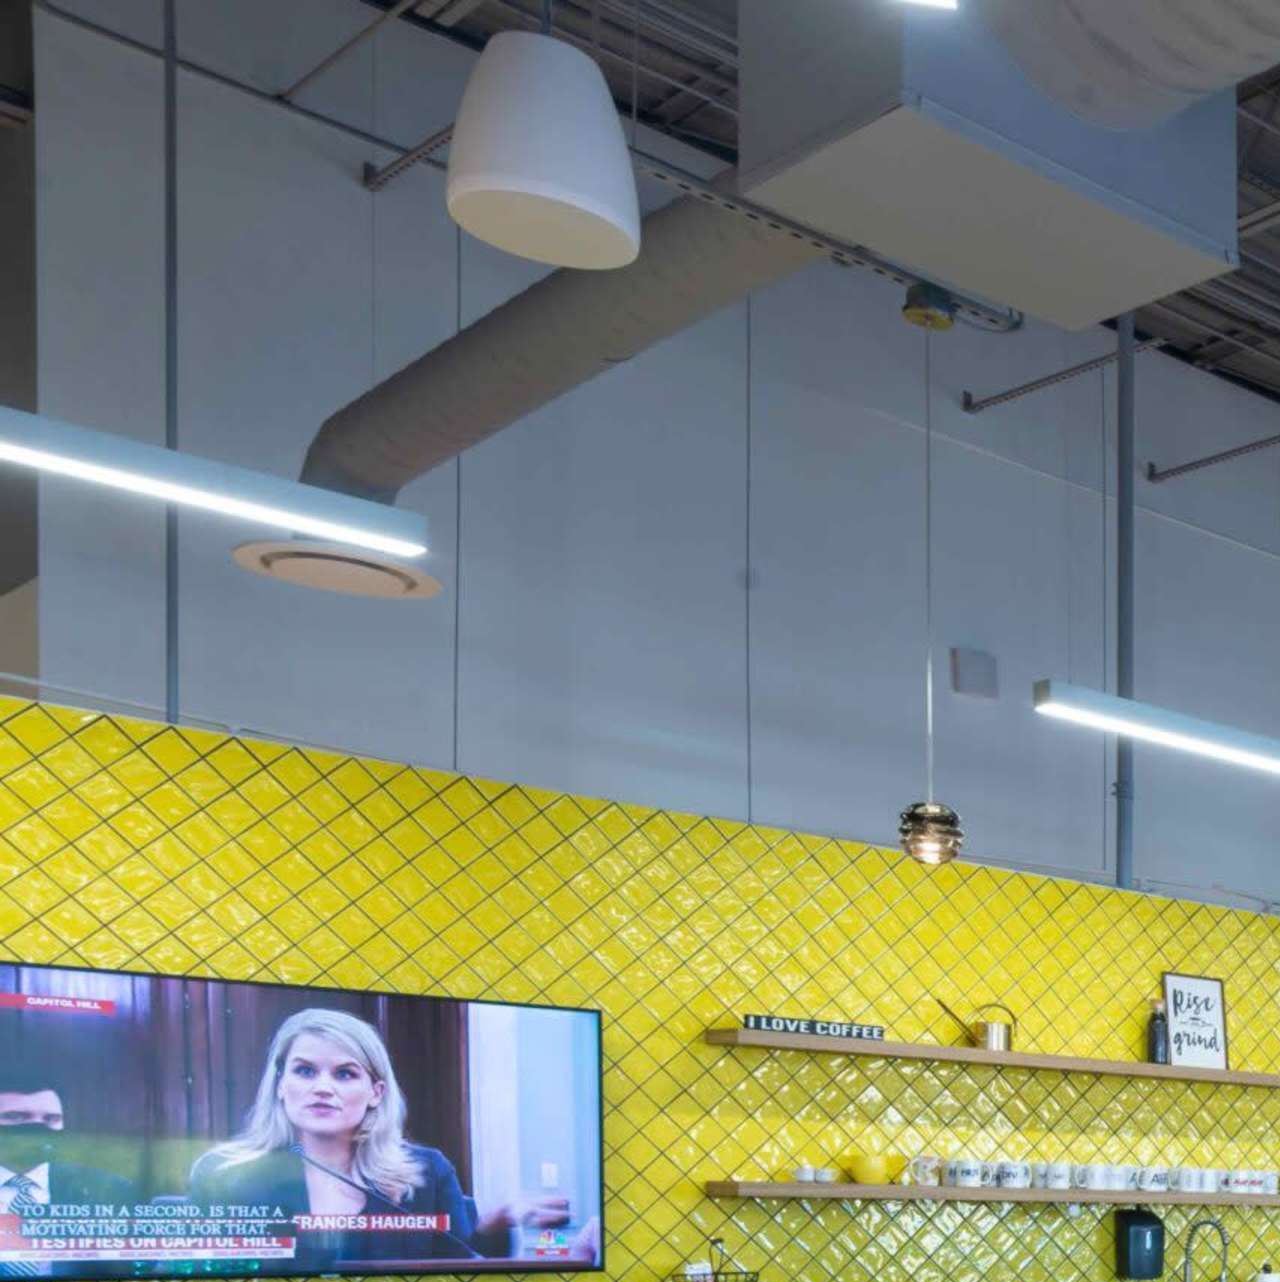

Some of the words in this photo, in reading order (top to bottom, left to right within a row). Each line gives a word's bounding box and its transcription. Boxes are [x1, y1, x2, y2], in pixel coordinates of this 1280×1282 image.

[1173, 988, 1214, 1017] Rise
[748, 1015, 755, 1028] I
[761, 1017, 811, 1033] LOVE
[815, 1022, 882, 1039] COFFEE
[1173, 1028, 1219, 1056] grind
[23, 1205, 45, 1217] TO
[50, 1205, 90, 1217] KIDS
[95, 1205, 114, 1217] IN
[119, 1205, 130, 1217] A
[210, 1206, 224, 1217] IS
[228, 1206, 269, 1217] THAT
[273, 1206, 284, 1217] A
[371, 1216, 438, 1229] HAUGEN
[22, 1224, 128, 1236] MOTIVATING
[134, 1224, 186, 1235] FORCE
[190, 1224, 222, 1235] FOR
[225, 1224, 271, 1235] THAT.
[32, 1237, 125, 1249] TESTIFIES
[129, 1237, 157, 1248] ON
[161, 1237, 240, 1248] CAPITOL
[242, 1237, 282, 1248] HILL
